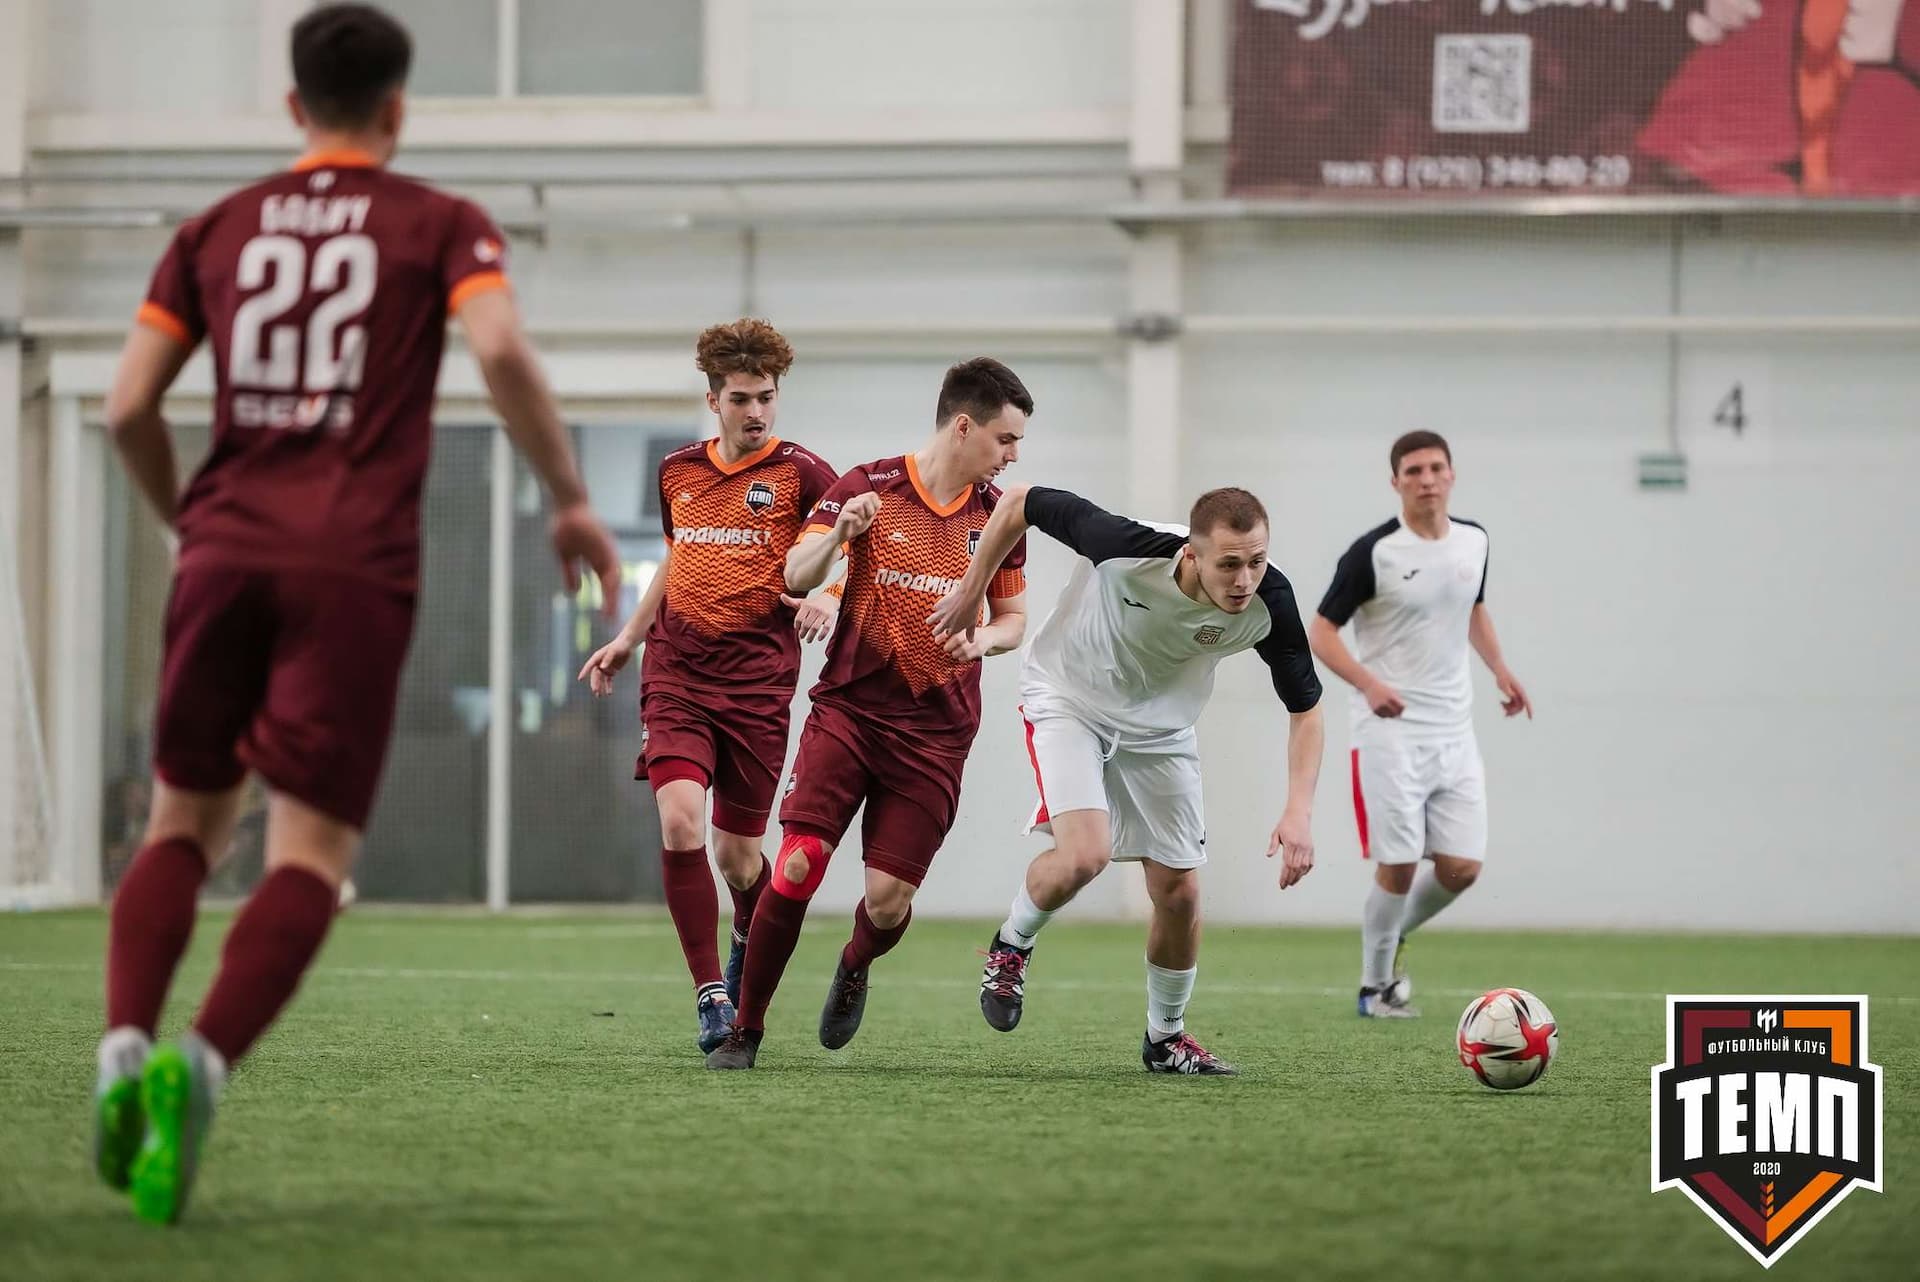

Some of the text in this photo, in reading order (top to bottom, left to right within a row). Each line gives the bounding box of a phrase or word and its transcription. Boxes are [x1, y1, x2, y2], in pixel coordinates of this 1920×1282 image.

[229, 233, 379, 392] 22
[1714, 381, 1749, 435] 4
[747, 490, 773, 506] ТЕМП
